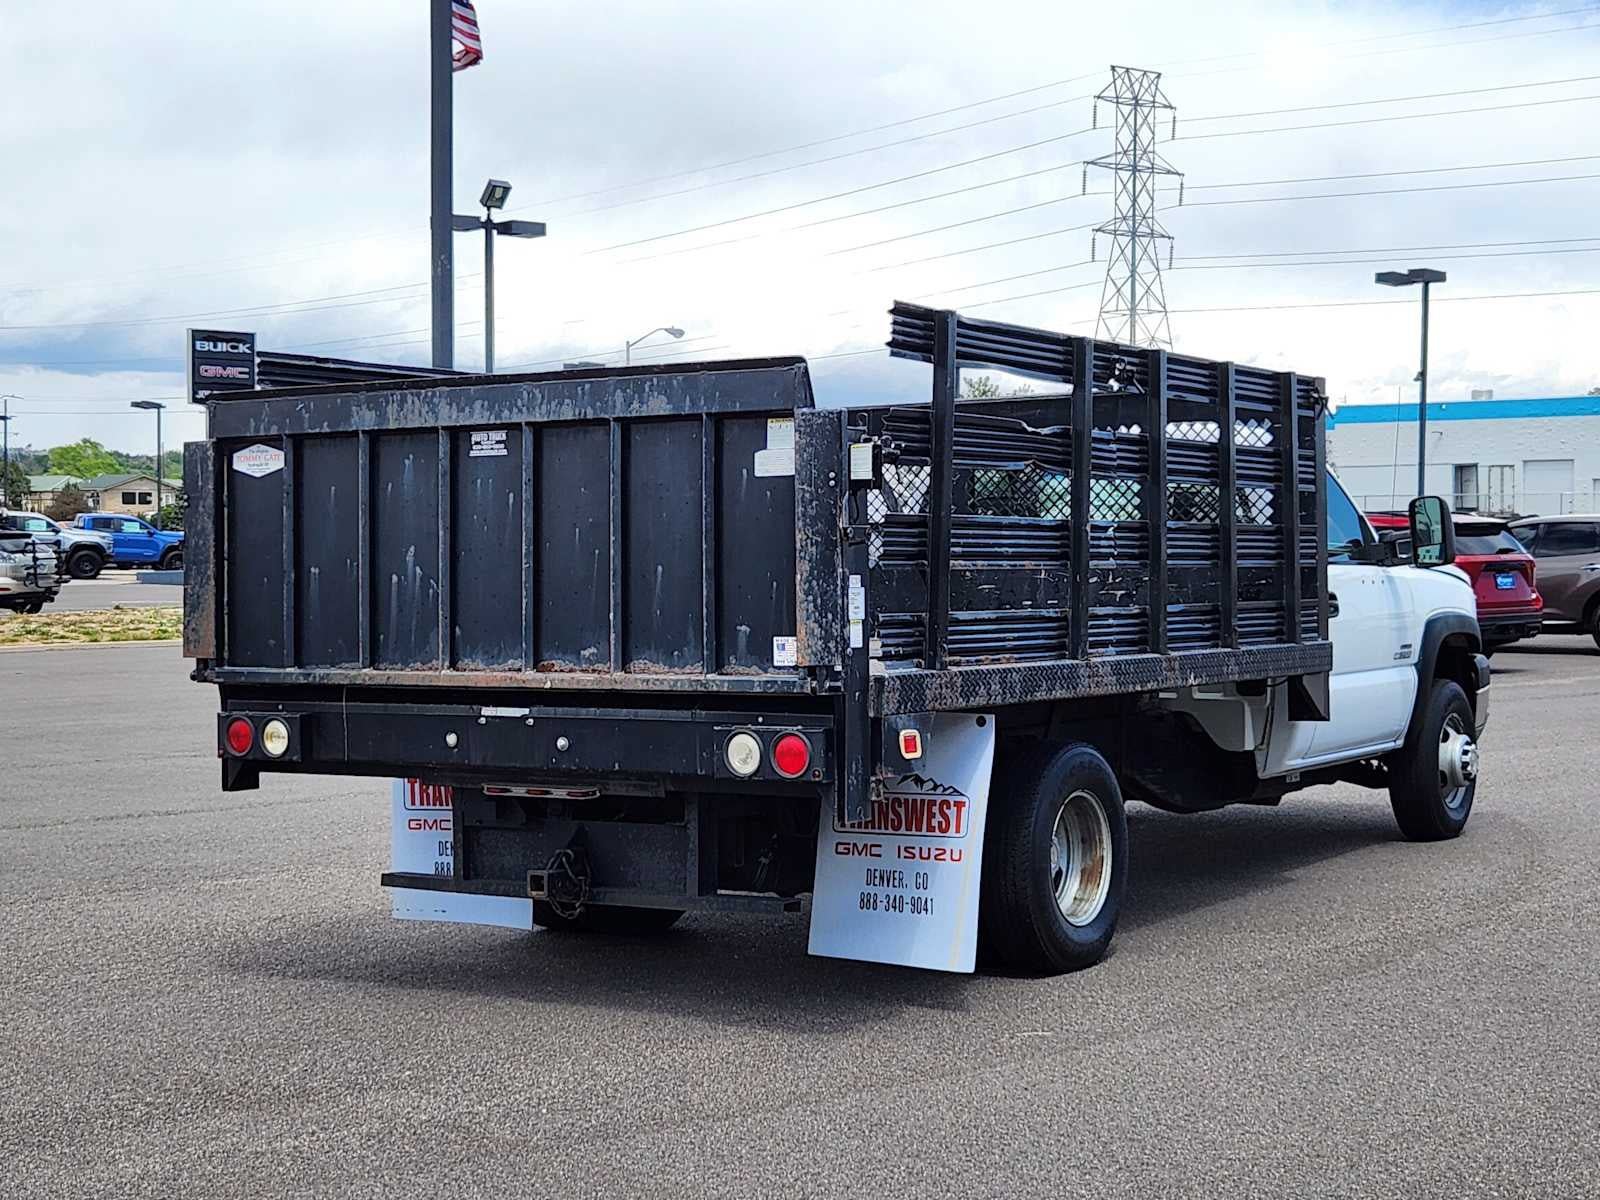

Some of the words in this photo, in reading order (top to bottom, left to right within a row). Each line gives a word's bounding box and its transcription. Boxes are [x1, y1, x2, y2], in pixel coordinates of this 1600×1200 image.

[195, 340, 252, 354] BUICK
[200, 365, 250, 379] GMC
[237, 454, 262, 462] TOMMY
[840, 798, 966, 834] NSWEST
[408, 818, 452, 831] GMC
[835, 841, 883, 858] GMC
[897, 844, 962, 862] ISUZU
[915, 872, 929, 891] CO
[859, 891, 935, 916] 888-340-9041
